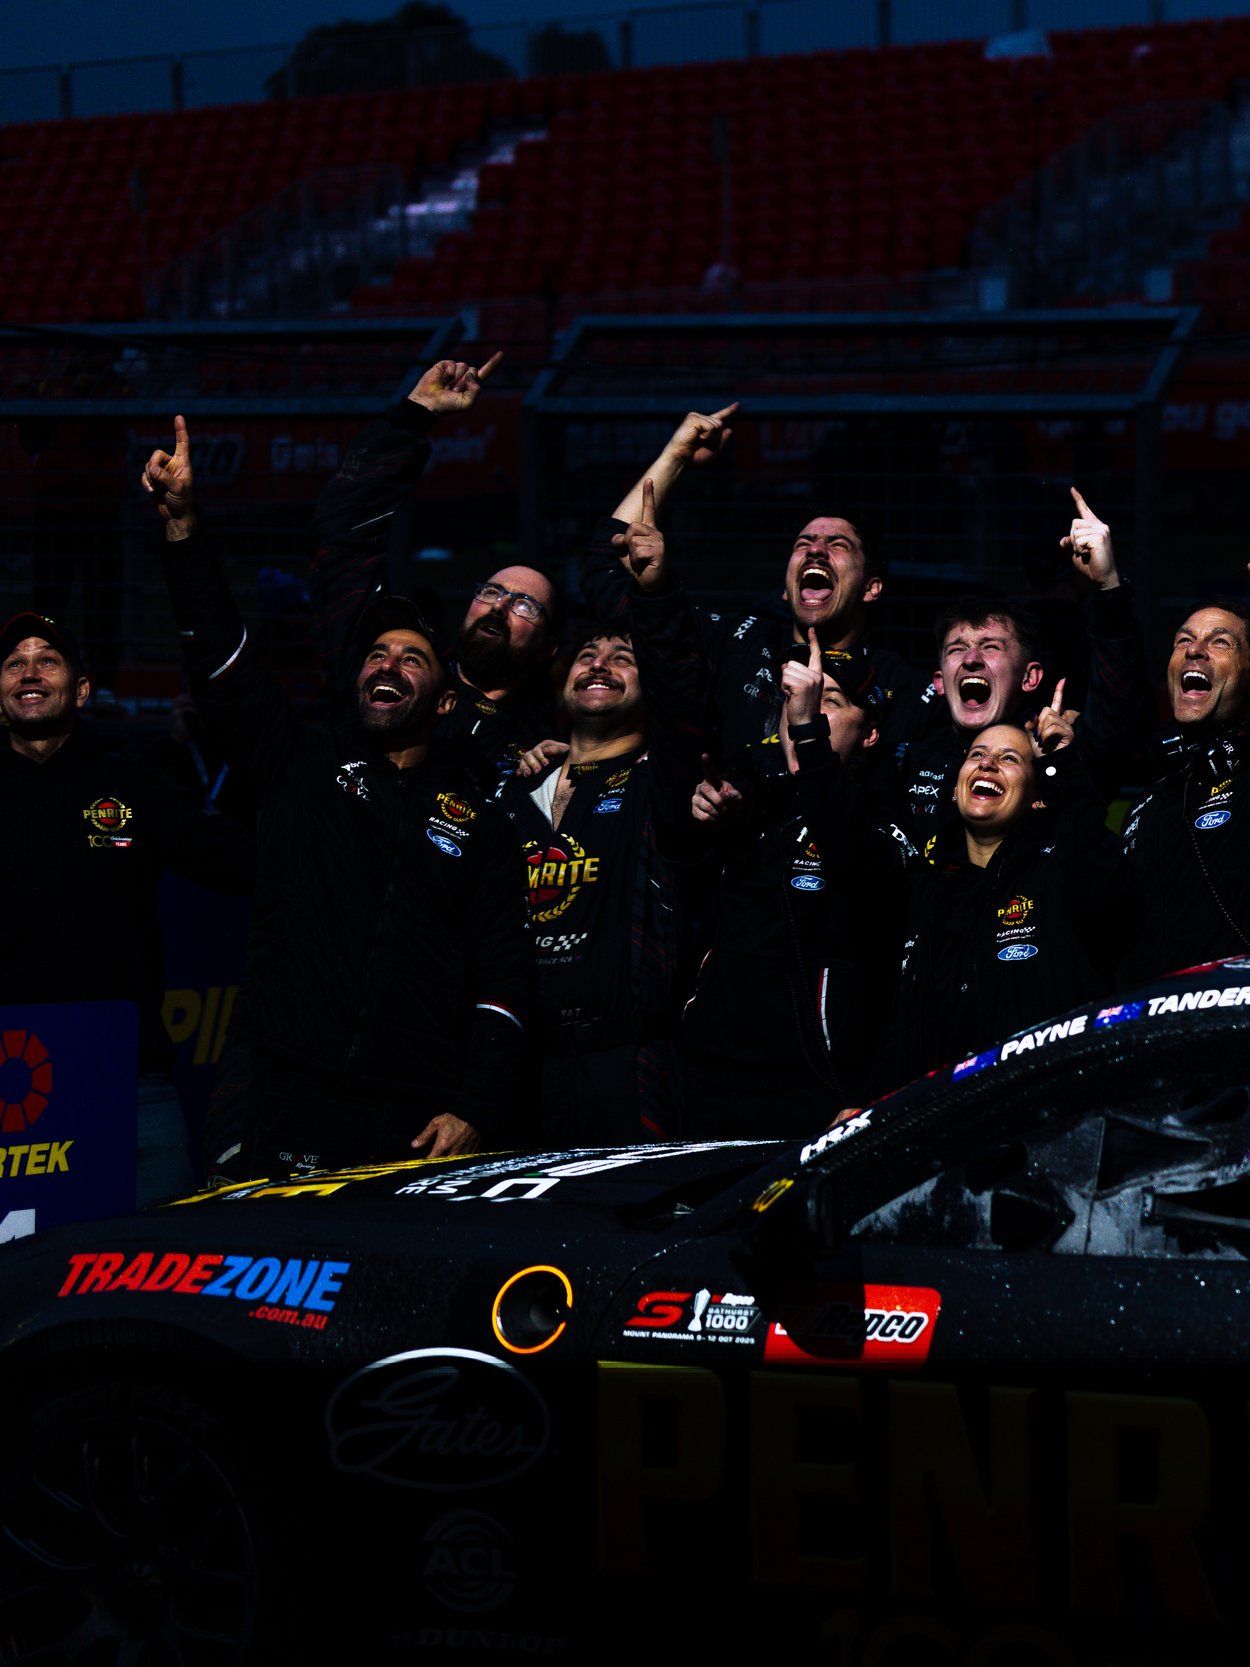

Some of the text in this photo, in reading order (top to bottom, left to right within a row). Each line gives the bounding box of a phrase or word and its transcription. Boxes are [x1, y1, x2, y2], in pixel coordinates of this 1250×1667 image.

[83, 807, 133, 819] PENRITE
[436, 793, 478, 820] PENRITE
[429, 816, 458, 831] RACING
[796, 876, 820, 889] Ford
[1005, 945, 1030, 959] Ford
[1000, 1014, 1089, 1062] PAYNE
[279, 1151, 320, 1165] GROVE
[58, 1251, 351, 1312] TRADEZONE
[249, 1305, 328, 1331] .com.au
[708, 1307, 755, 1316] BATHURST
[705, 1314, 748, 1330] 1000
[652, 1331, 694, 1341] PANORAMA
[329, 1366, 545, 1473] Gates
[424, 1548, 519, 1579] ACL
[413, 1628, 567, 1655] DUNLOP
